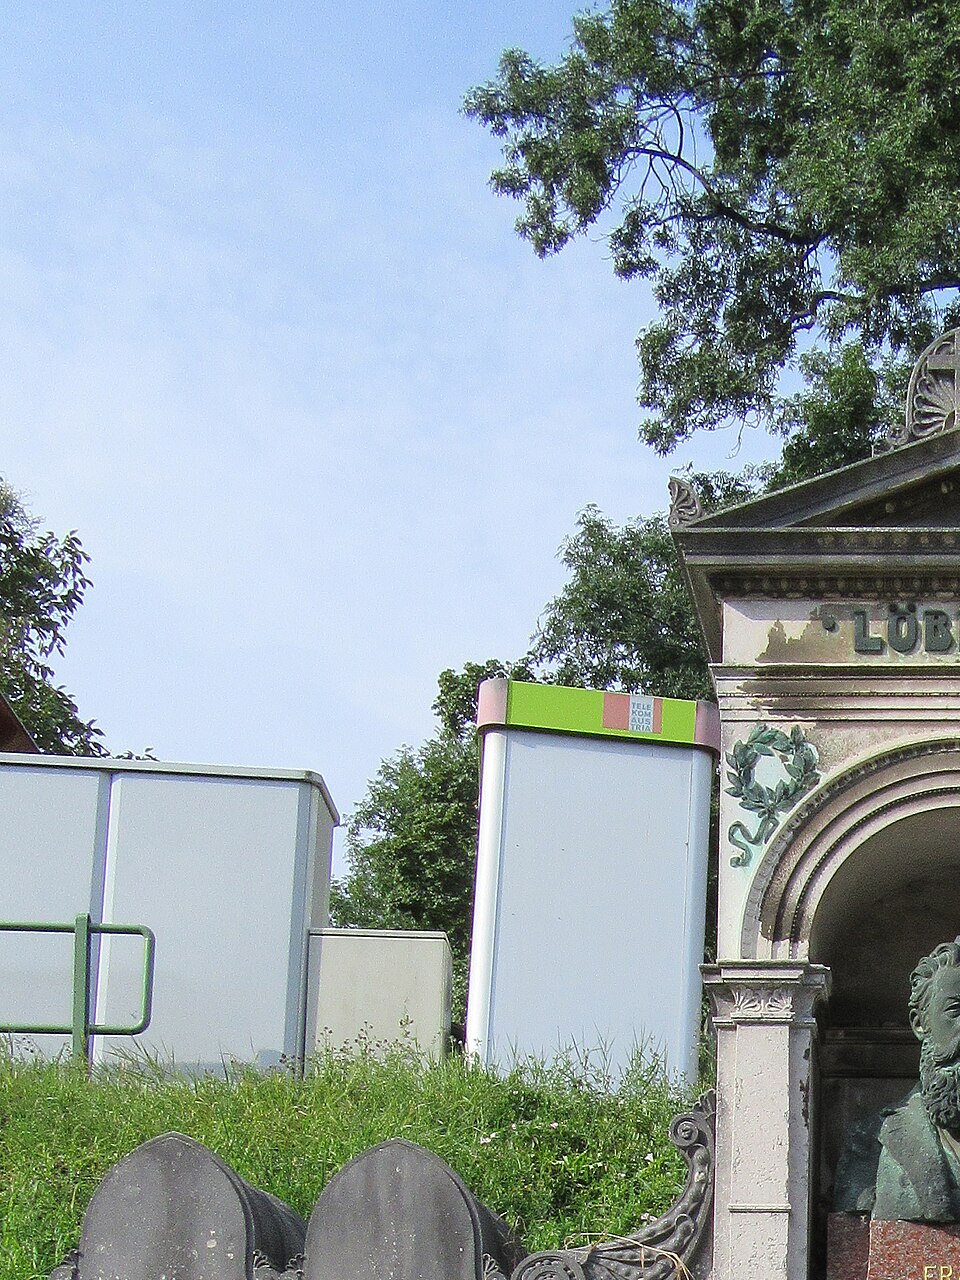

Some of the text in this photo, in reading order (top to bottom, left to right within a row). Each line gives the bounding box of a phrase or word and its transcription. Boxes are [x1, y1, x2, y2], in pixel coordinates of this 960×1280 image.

[631, 702, 652, 710] TELE
[631, 716, 651, 725] AUS
[630, 723, 651, 731] TRIA
